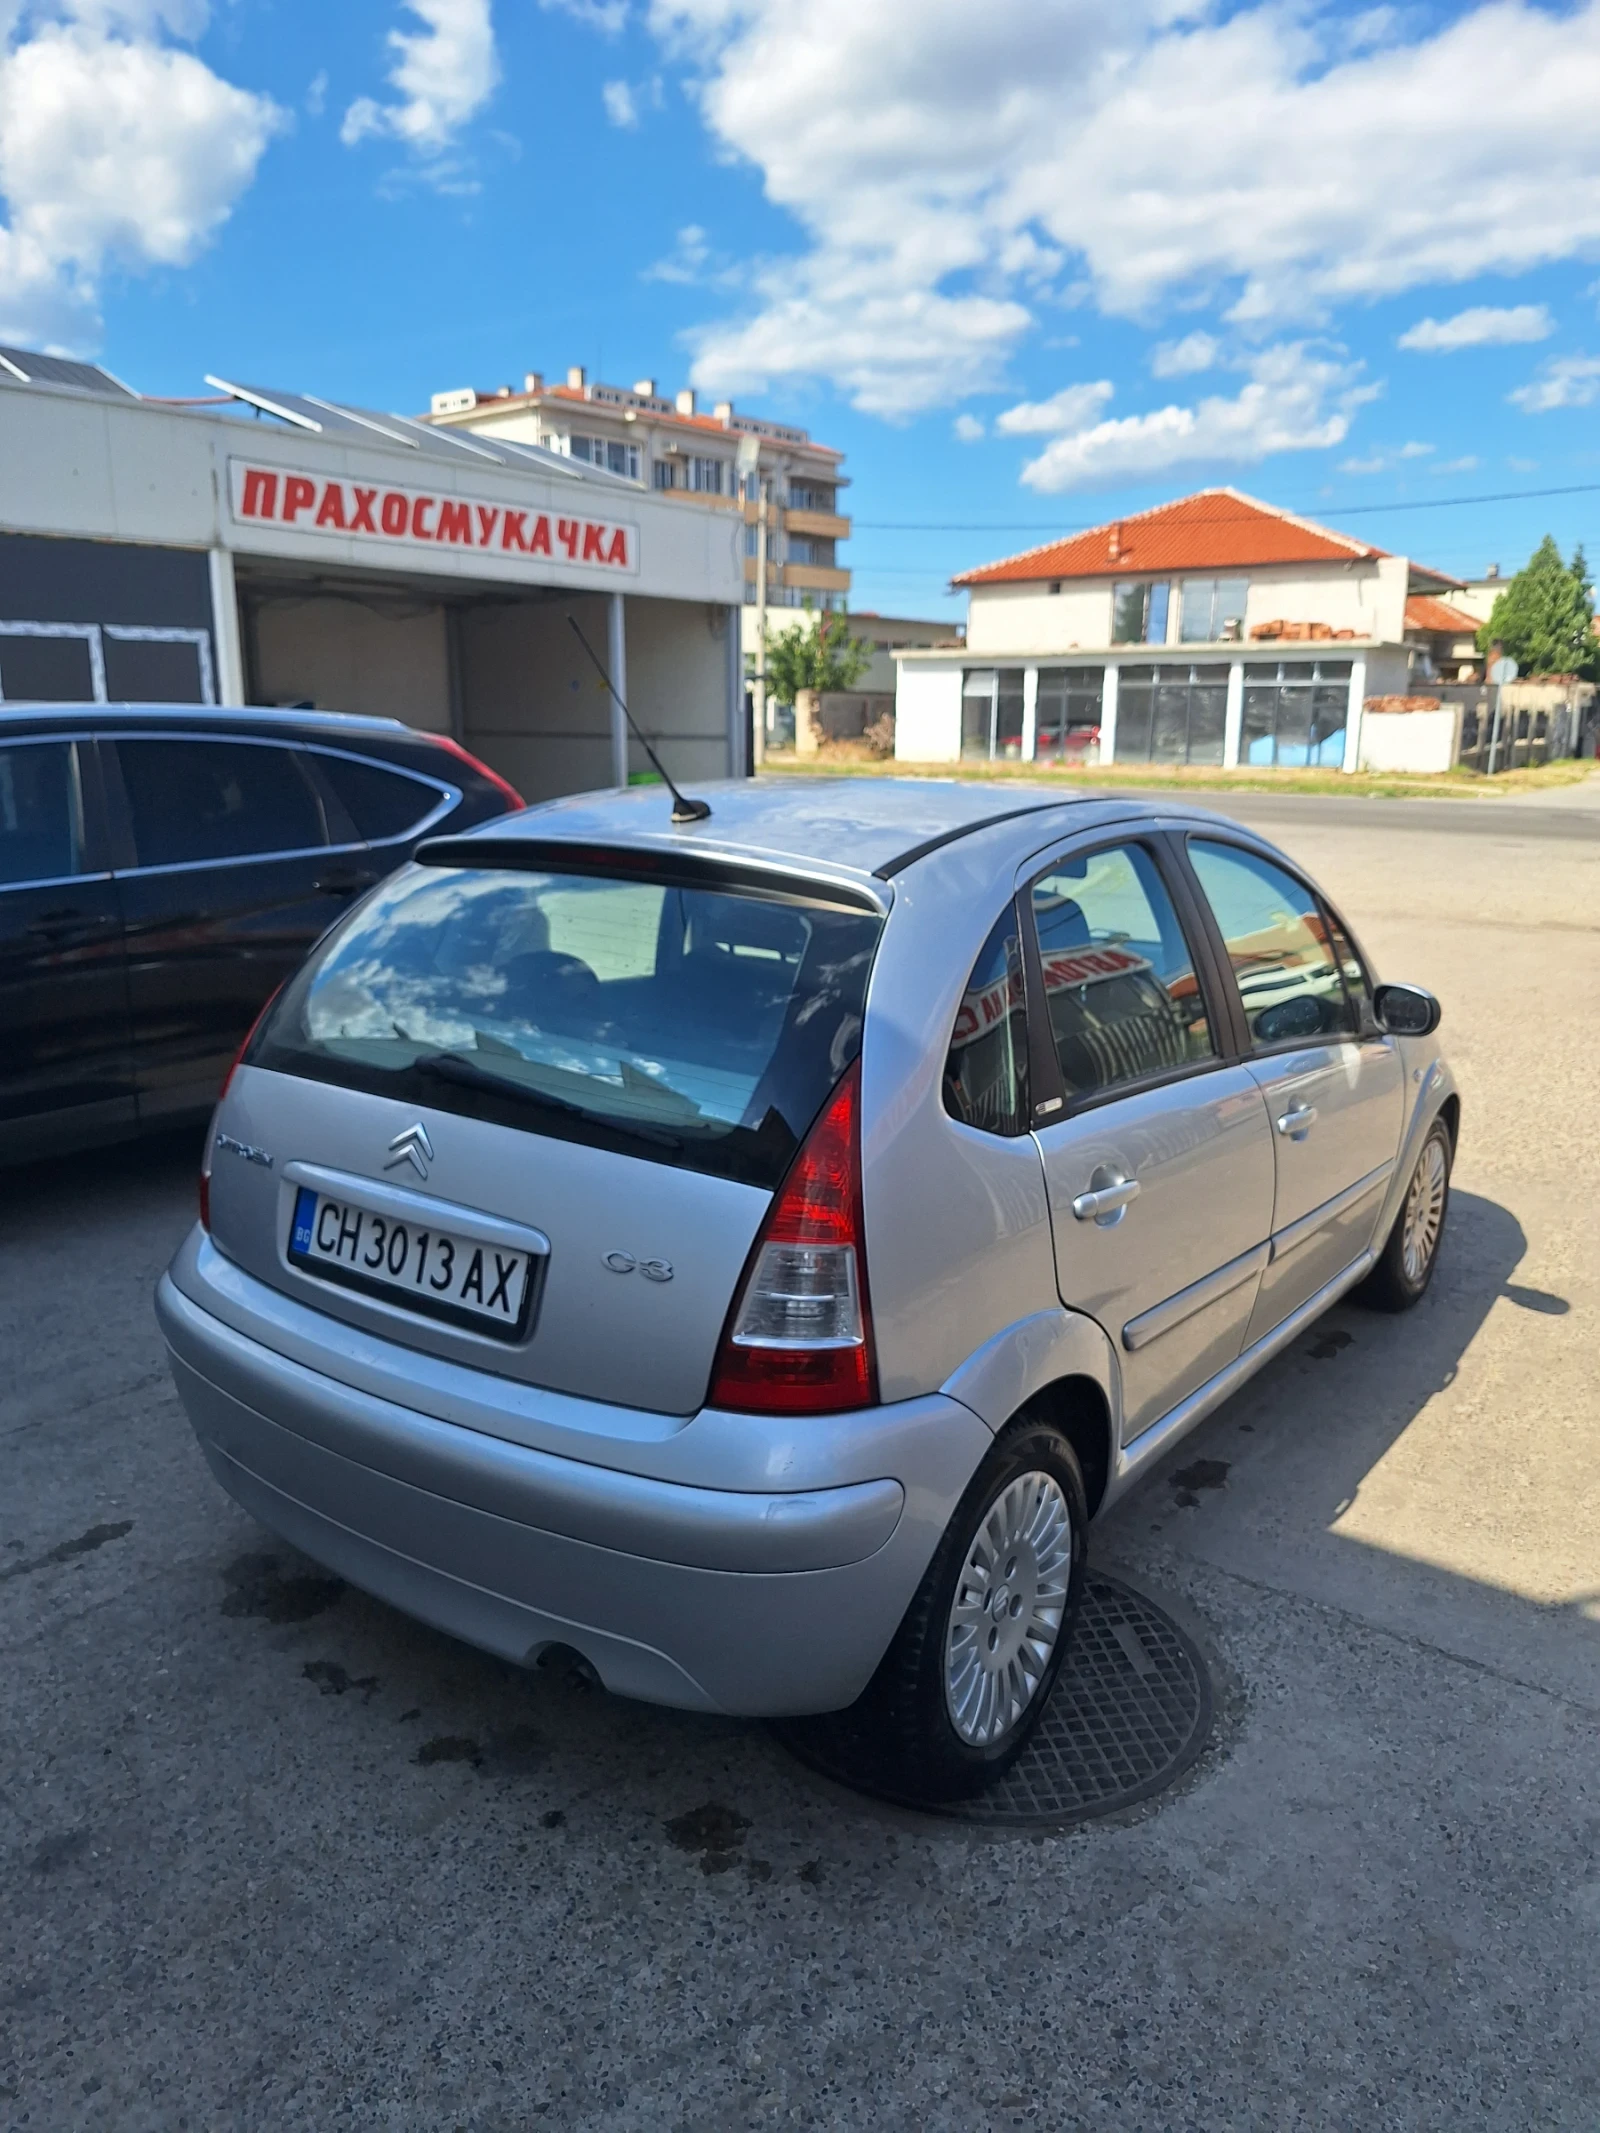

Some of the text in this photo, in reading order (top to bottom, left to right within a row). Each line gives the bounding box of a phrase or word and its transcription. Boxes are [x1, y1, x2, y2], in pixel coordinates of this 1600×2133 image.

[242, 470, 628, 567] ПРАХОСМУКАЧКА
[296, 1226, 311, 1244] BG
[600, 1249, 675, 1282] C3
